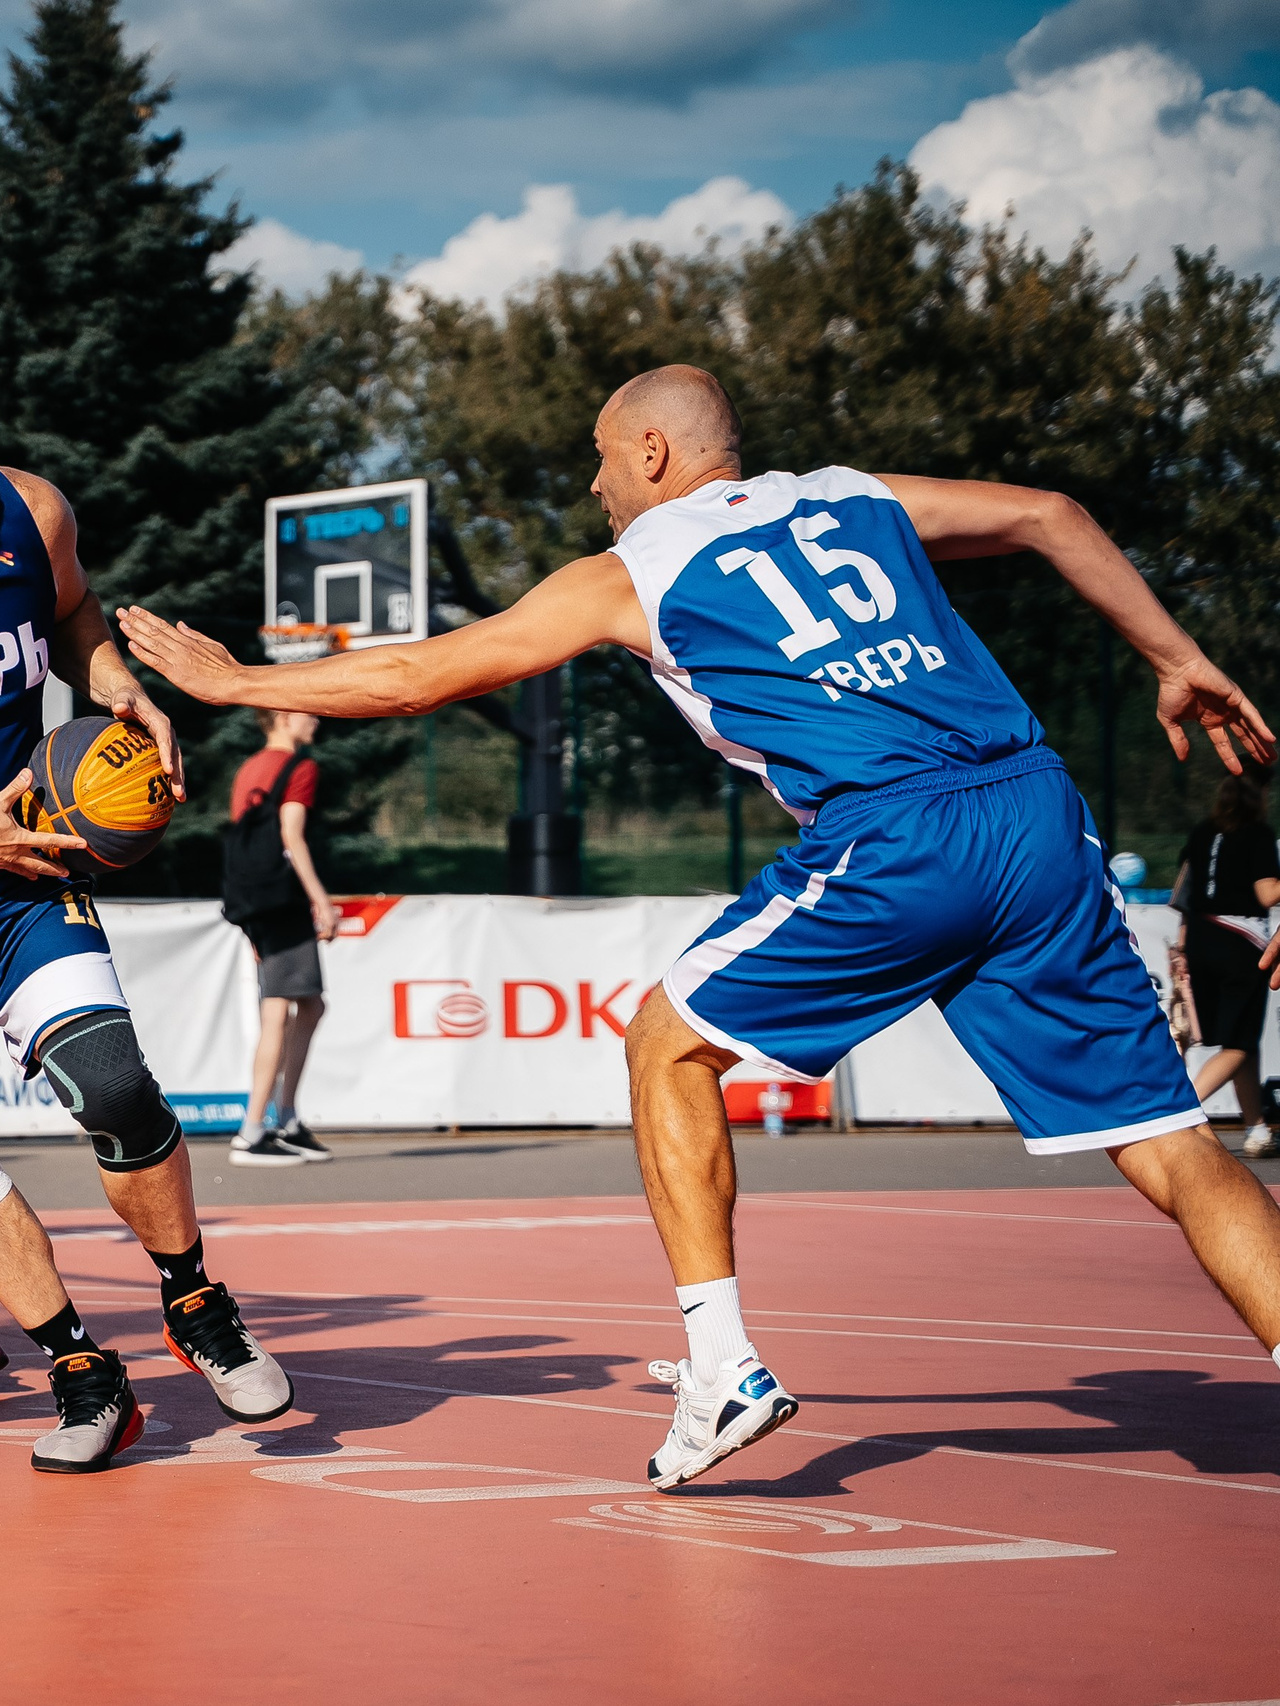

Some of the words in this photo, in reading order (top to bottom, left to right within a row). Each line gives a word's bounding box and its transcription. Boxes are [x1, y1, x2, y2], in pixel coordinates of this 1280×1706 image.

[715, 511, 896, 663] 15
[804, 634, 948, 703] ТВЕРЬ
[503, 980, 658, 1039] DK
